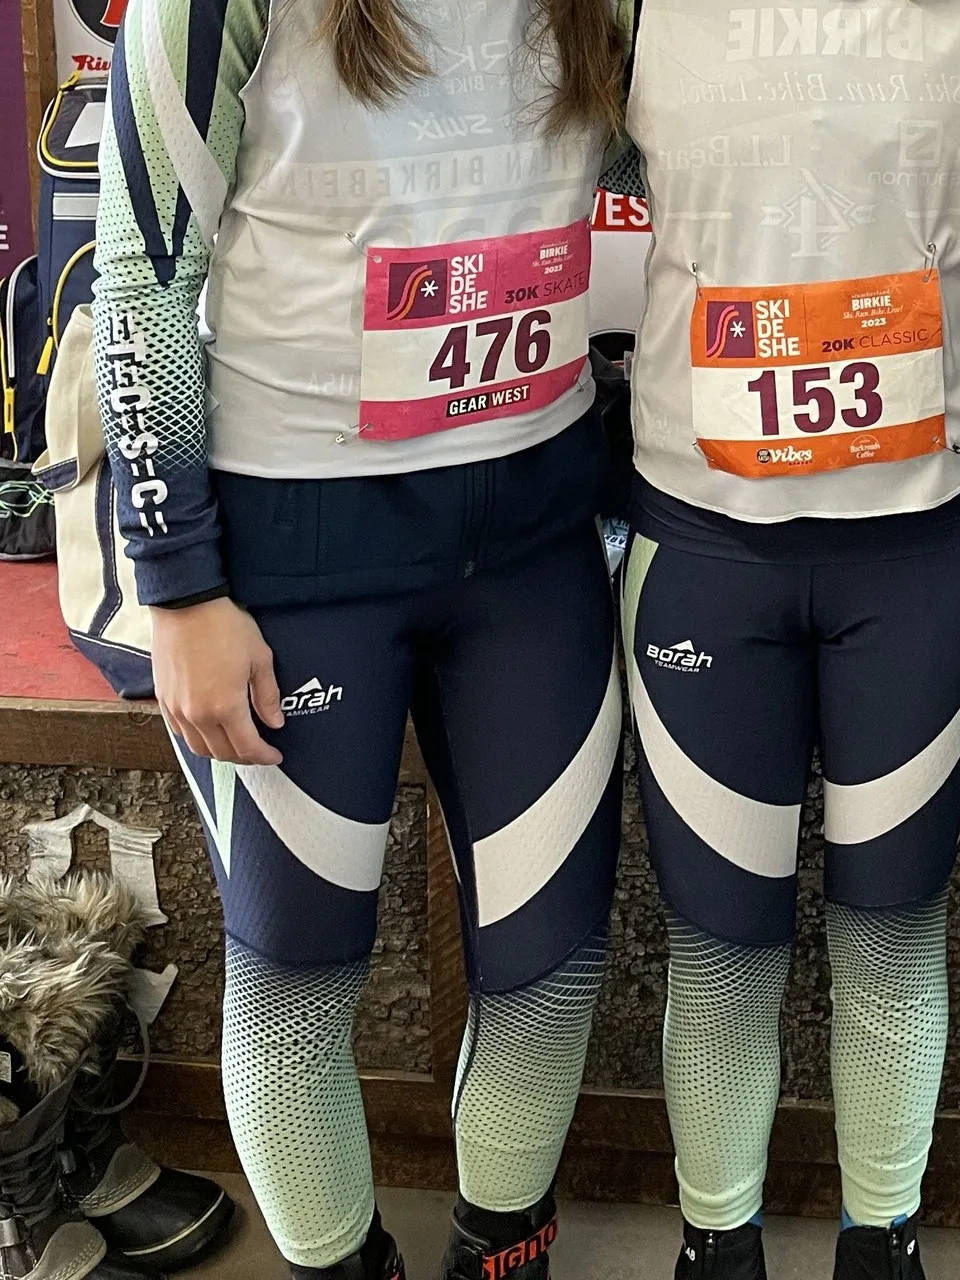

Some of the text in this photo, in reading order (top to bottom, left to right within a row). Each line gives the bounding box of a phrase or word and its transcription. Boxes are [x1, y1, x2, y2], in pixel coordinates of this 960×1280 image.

[540, 245, 568, 260] BIRKIE
[450, 253, 483, 276] SKI
[544, 265, 563, 274] 2023
[450, 274, 477, 296] DE
[504, 271, 585, 305] 30K SKATE
[449, 291, 488, 314] SHE
[755, 299, 790, 320] SKI
[851, 295, 891, 311] BIRKIE
[757, 320, 785, 338] DE
[861, 317, 887, 328] 2023
[429, 309, 552, 390] 476
[758, 337, 800, 358] SHE
[822, 328, 928, 353] 20K CLASSIC
[449, 385, 530, 415] GEAR WEST
[747, 361, 883, 436] 153
[281, 684, 343, 711] orah
